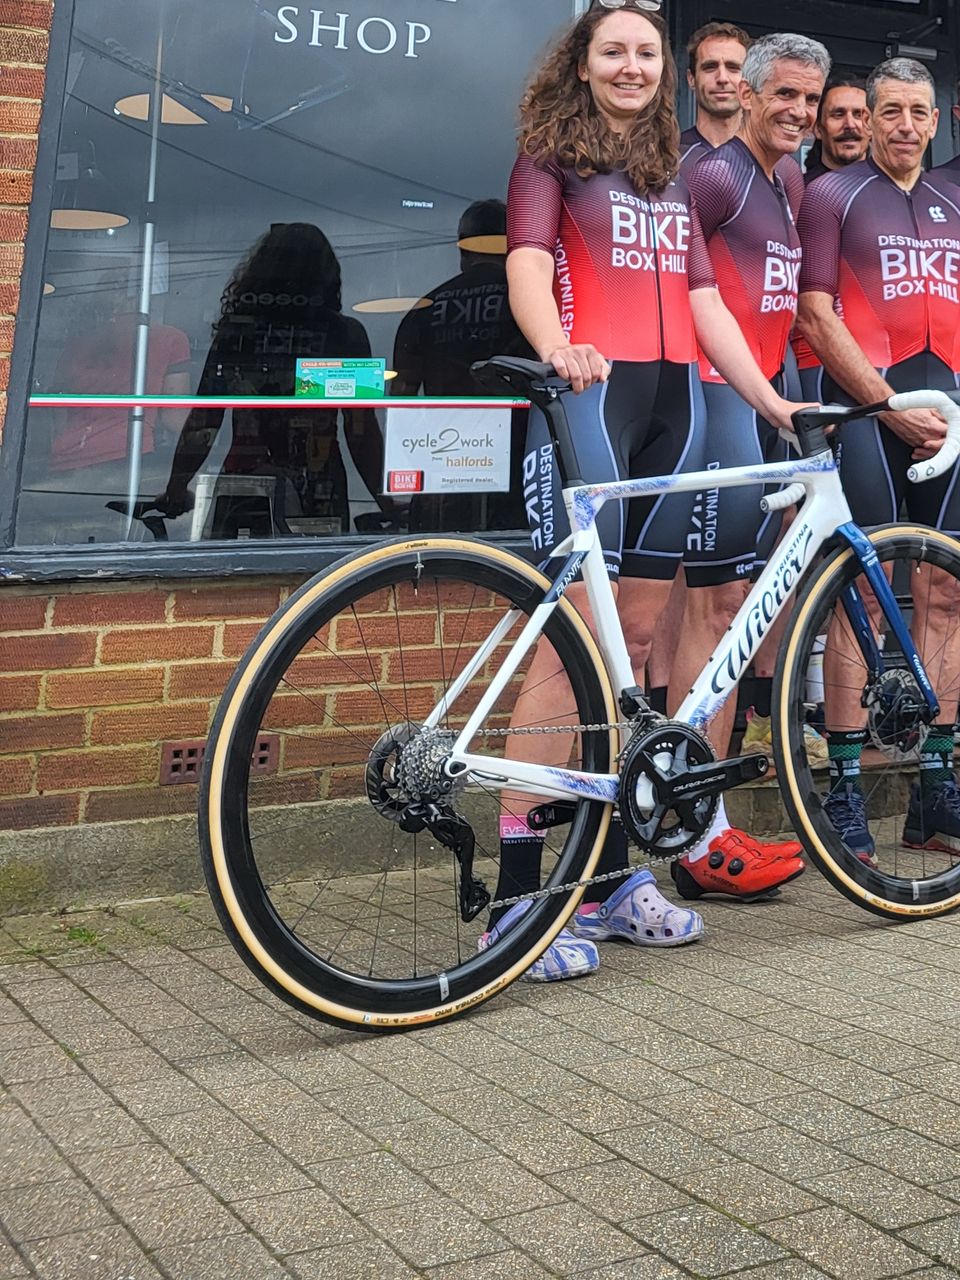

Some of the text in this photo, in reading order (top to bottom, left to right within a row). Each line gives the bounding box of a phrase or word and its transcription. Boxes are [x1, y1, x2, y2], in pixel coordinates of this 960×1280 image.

[273, 5, 432, 59] SHOP
[608, 190, 688, 214] DESTINATION
[611, 204, 690, 252] BIKE
[878, 234, 960, 251] DESTINATION
[611, 247, 687, 274] BOX HILL
[880, 248, 960, 285] BIKE
[760, 294, 792, 313] BOX
[882, 279, 960, 304] BOX HILL
[402, 428, 494, 455] cycle2work
[446, 455, 494, 468] halfords
[394, 474, 417, 484] BIKE
[539, 443, 555, 550] DESTINATION
[704, 461, 720, 551] DTINATION
[774, 522, 810, 578] TRIESTINA
[554, 557, 583, 598] FILANTE
[711, 528, 814, 695] Wilier
[434, 1008, 453, 1017] PRO
[455, 992, 484, 1011] CORSA
